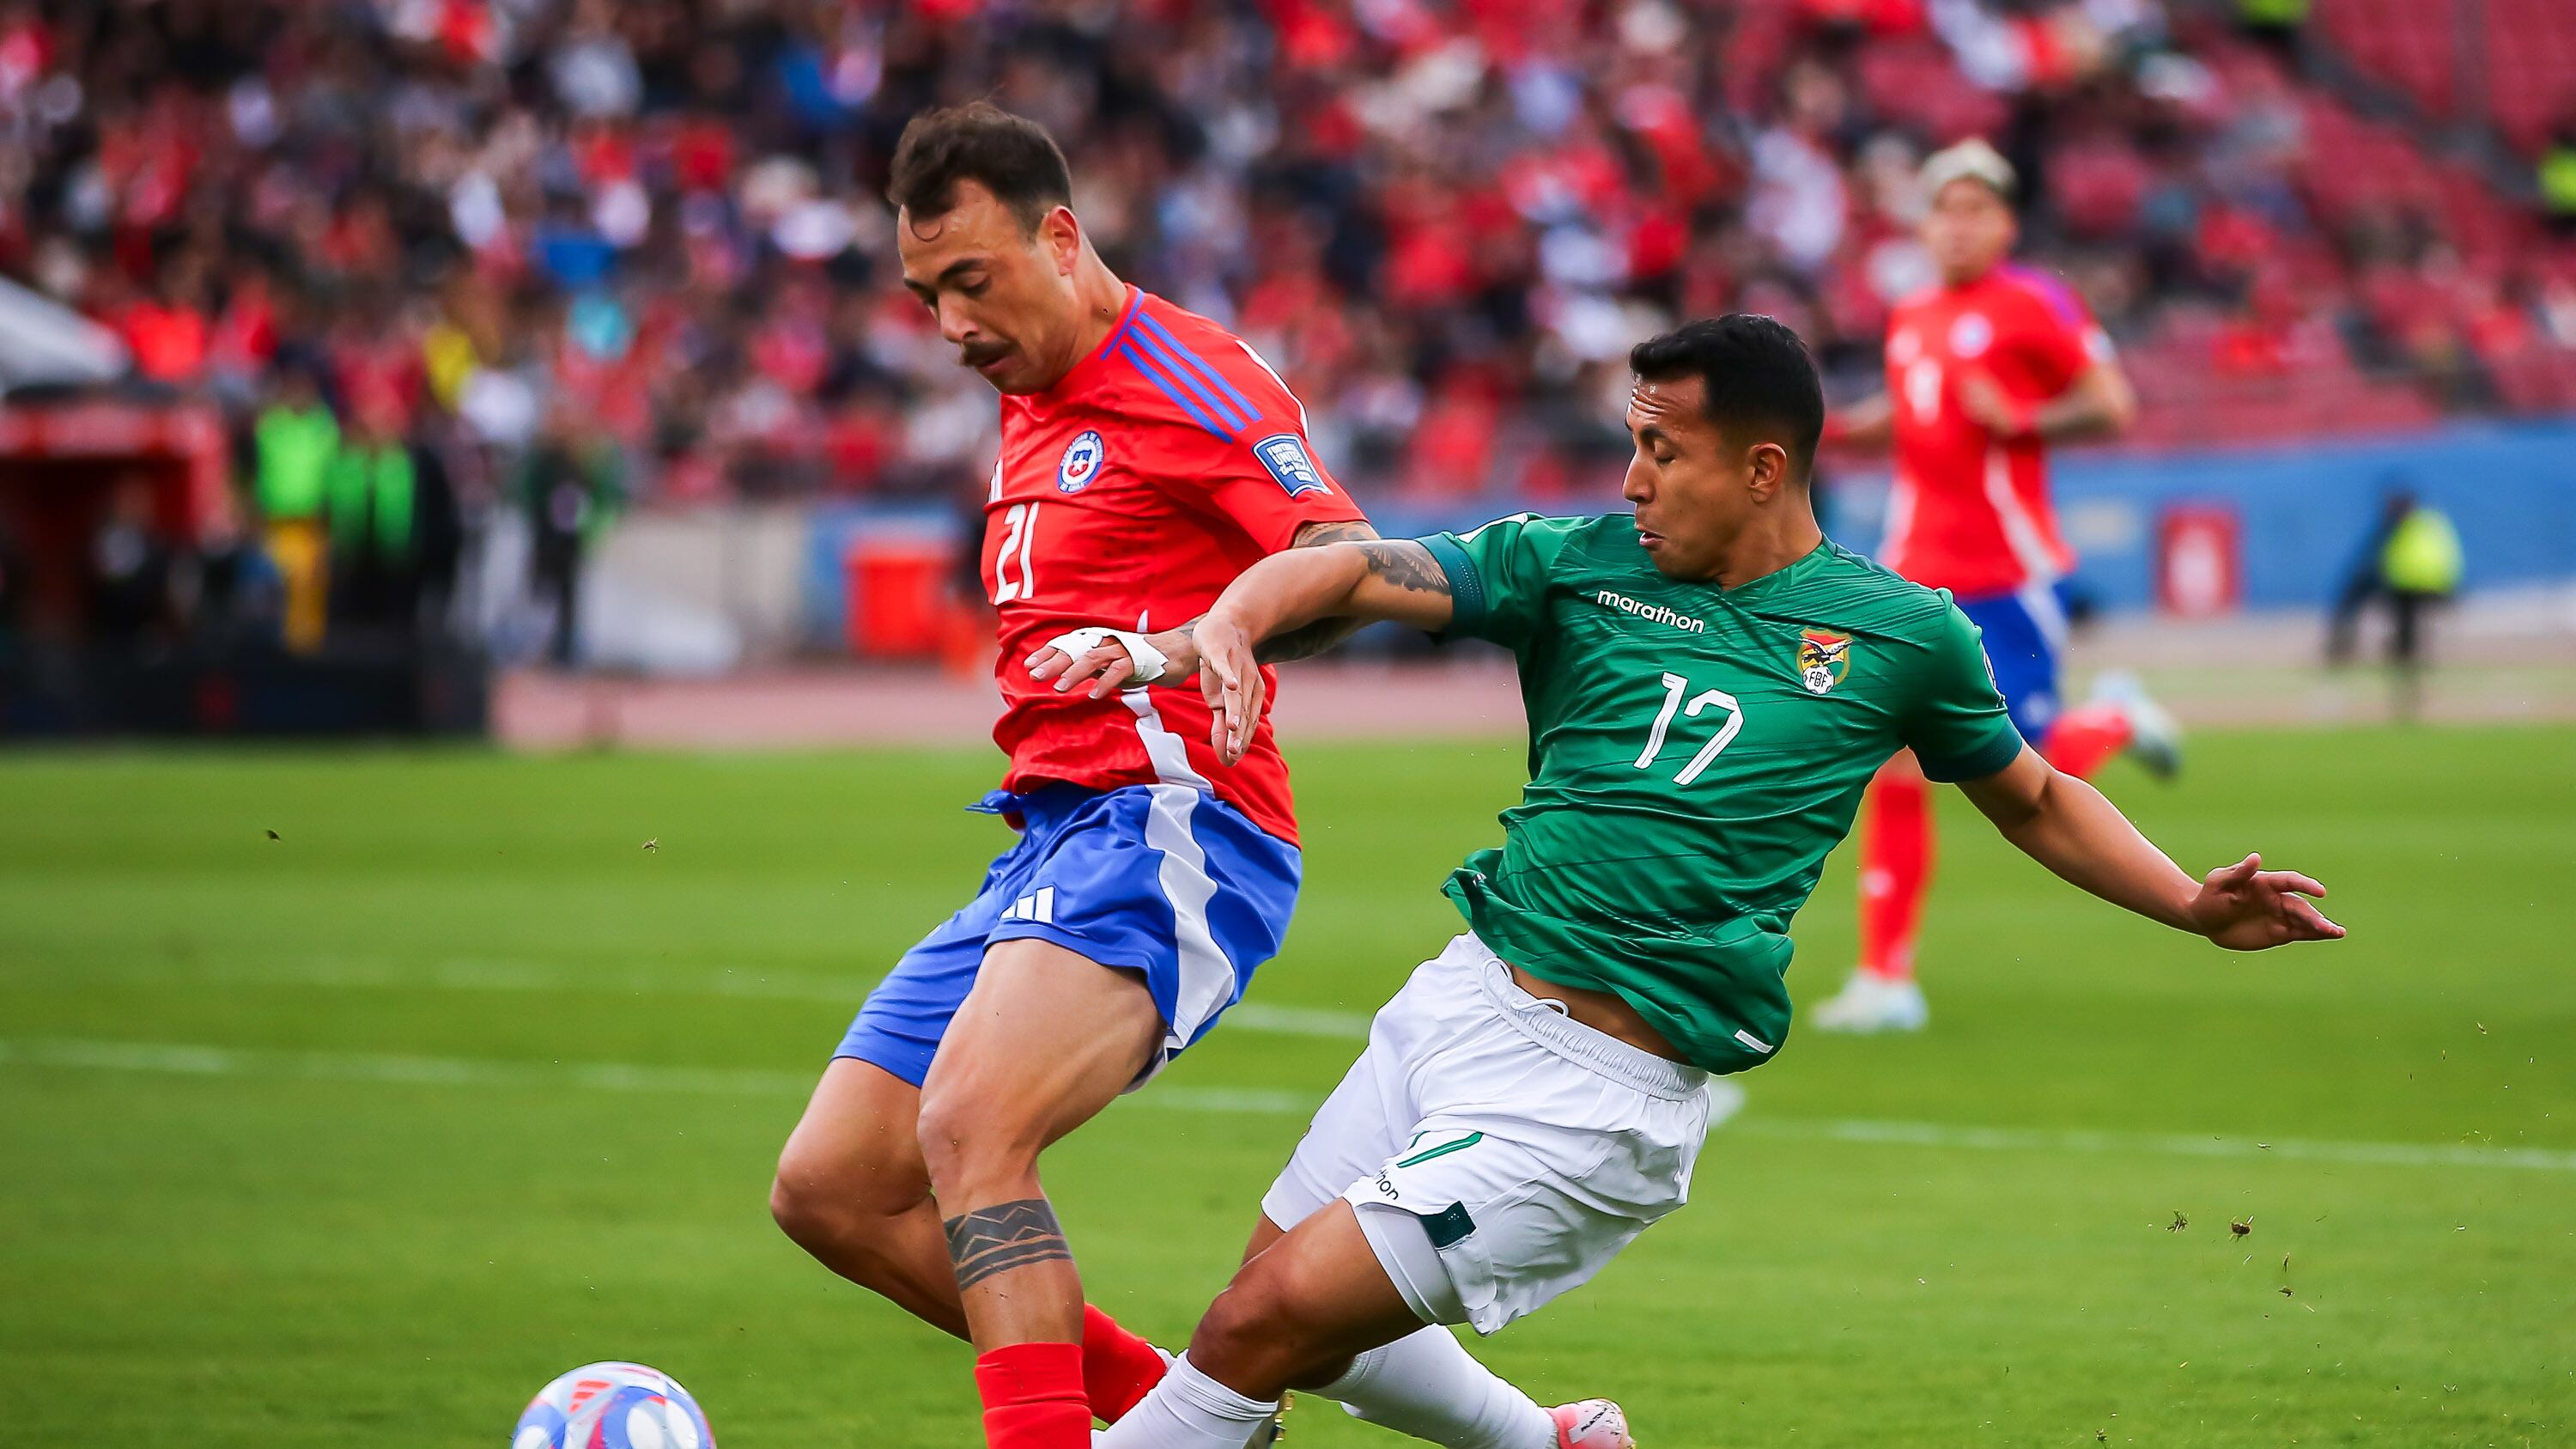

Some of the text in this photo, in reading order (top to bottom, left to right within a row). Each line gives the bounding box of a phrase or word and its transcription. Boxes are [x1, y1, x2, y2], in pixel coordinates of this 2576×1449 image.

[993, 501, 1040, 606] 21
[1597, 589, 1705, 634] marathon
[1808, 671, 1828, 688] FBF
[1633, 672, 1745, 786] 17
